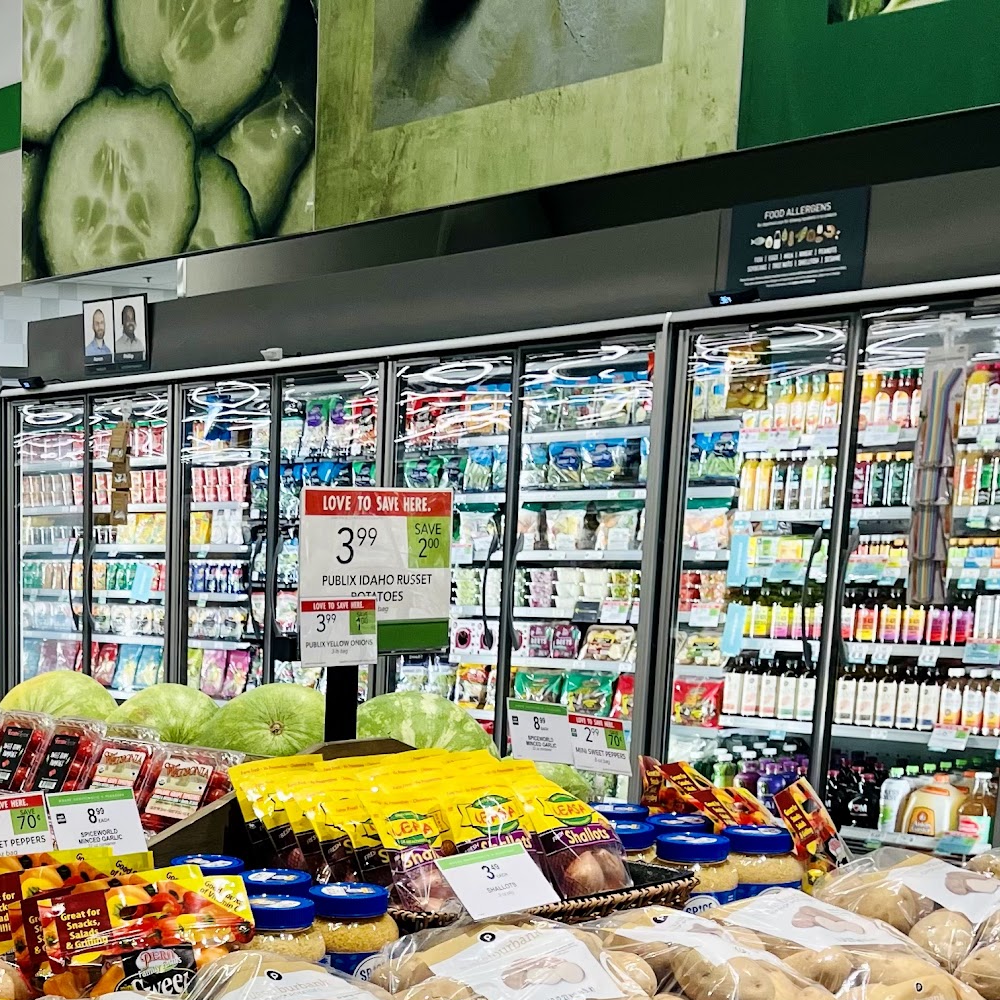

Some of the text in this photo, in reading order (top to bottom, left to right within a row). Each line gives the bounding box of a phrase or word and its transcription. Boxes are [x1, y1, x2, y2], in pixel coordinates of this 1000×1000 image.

[764, 208, 785, 220] FOOD
[785, 202, 832, 217] ALLERGENS
[322, 495, 431, 512] LOVE TO SAVE HERE.
[414, 523, 442, 535] SAVE
[322, 574, 433, 586] PUBLIX IDAHO RUSSET
[313, 602, 326, 610] LOVE
[328, 602, 335, 610] TO
[336, 601, 349, 609] SAVE
[327, 640, 349, 648] YELLOW
[350, 639, 373, 647] ONIONS
[575, 716, 587, 724] LOVE
[575, 746, 626, 760] MINI SWEET PEPPERS
[10, 798, 29, 809] HERE.
[19, 807, 35, 815] SAVE
[80, 828, 118, 838] SPICEWORLD
[565, 827, 610, 846] Shallots
[10, 834, 47, 847] PEPPERS
[78, 834, 123, 845] MINCED GARLIC
[486, 882, 518, 894] SHALLOTS
[2, 892, 16, 901] for
[60, 908, 101, 921] Great for
[66, 920, 101, 930] Snacks,
[69, 928, 99, 940] Salads
